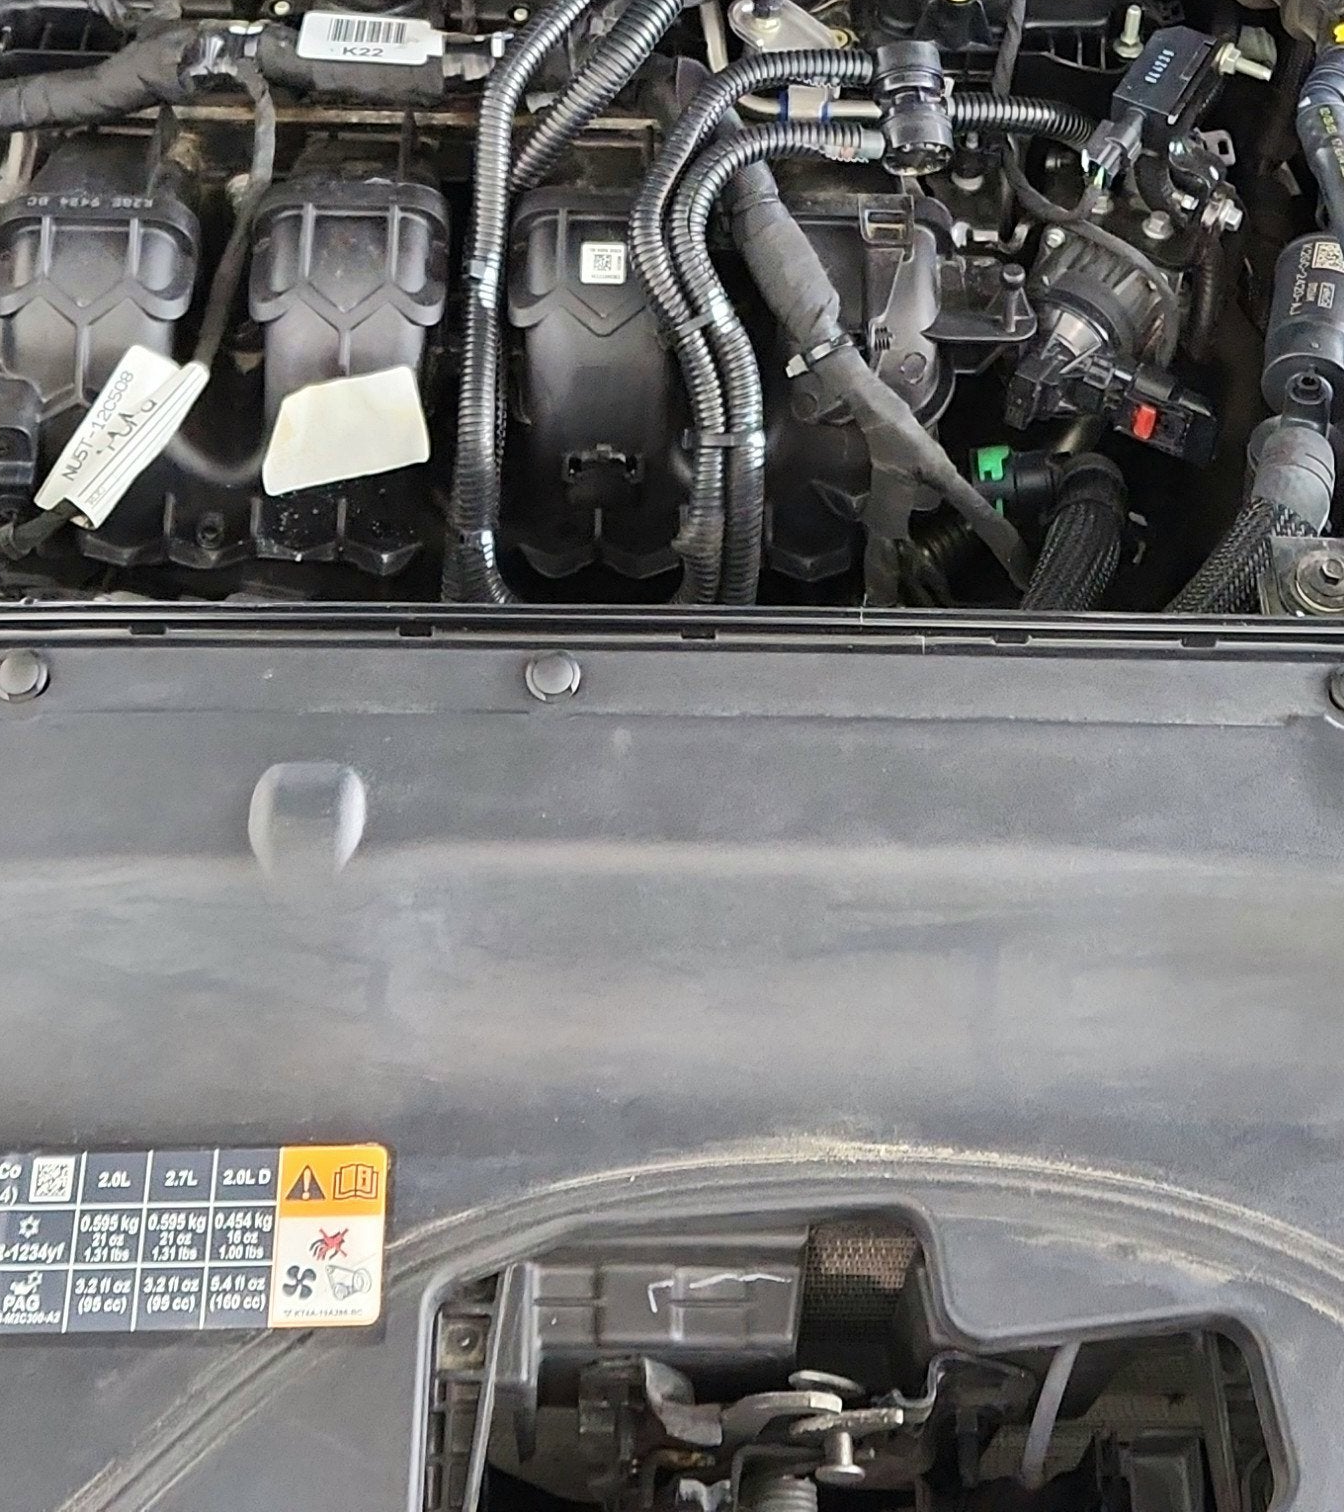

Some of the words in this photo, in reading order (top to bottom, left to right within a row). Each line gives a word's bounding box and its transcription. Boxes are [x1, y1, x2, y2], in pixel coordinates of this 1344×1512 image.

[343, 47, 383, 56] K22
[98, 1171, 130, 1188] 2.0L
[164, 1169, 197, 1186] 2.7L
[223, 1168, 255, 1185] 2.0L
[259, 1168, 271, 1185] D
[0, 1186, 18, 1206] 4)
[80, 1214, 118, 1232] 0.595
[120, 1213, 139, 1234] kg
[148, 1213, 186, 1231] 0.595
[188, 1213, 206, 1233] kg
[215, 1212, 253, 1230] 0.454
[255, 1212, 272, 1232] kg
[92, 1233, 106, 1246] 21
[108, 1234, 124, 1246] oz
[159, 1231, 173, 1245] 21
[176, 1233, 191, 1245] oz
[243, 1232, 258, 1244] oz
[84, 1247, 108, 1262] 1.31
[110, 1246, 129, 1261] lbs
[152, 1245, 175, 1260] 1.31
[178, 1245, 197, 1260] lbs
[219, 1245, 243, 1259] 1.00
[245, 1244, 264, 1259] lbs
[75, 1278, 98, 1294] 3.2
[113, 1280, 132, 1293] oz
[143, 1276, 167, 1293] 3.2
[182, 1278, 200, 1292] oz
[248, 1277, 265, 1291] oz
[2, 1294, 40, 1312] PAG
[78, 1295, 101, 1315] (95
[103, 1296, 127, 1314] cc)
[147, 1294, 170, 1314] (95
[172, 1295, 195, 1313] cc)
[243, 1294, 266, 1311] cc)
